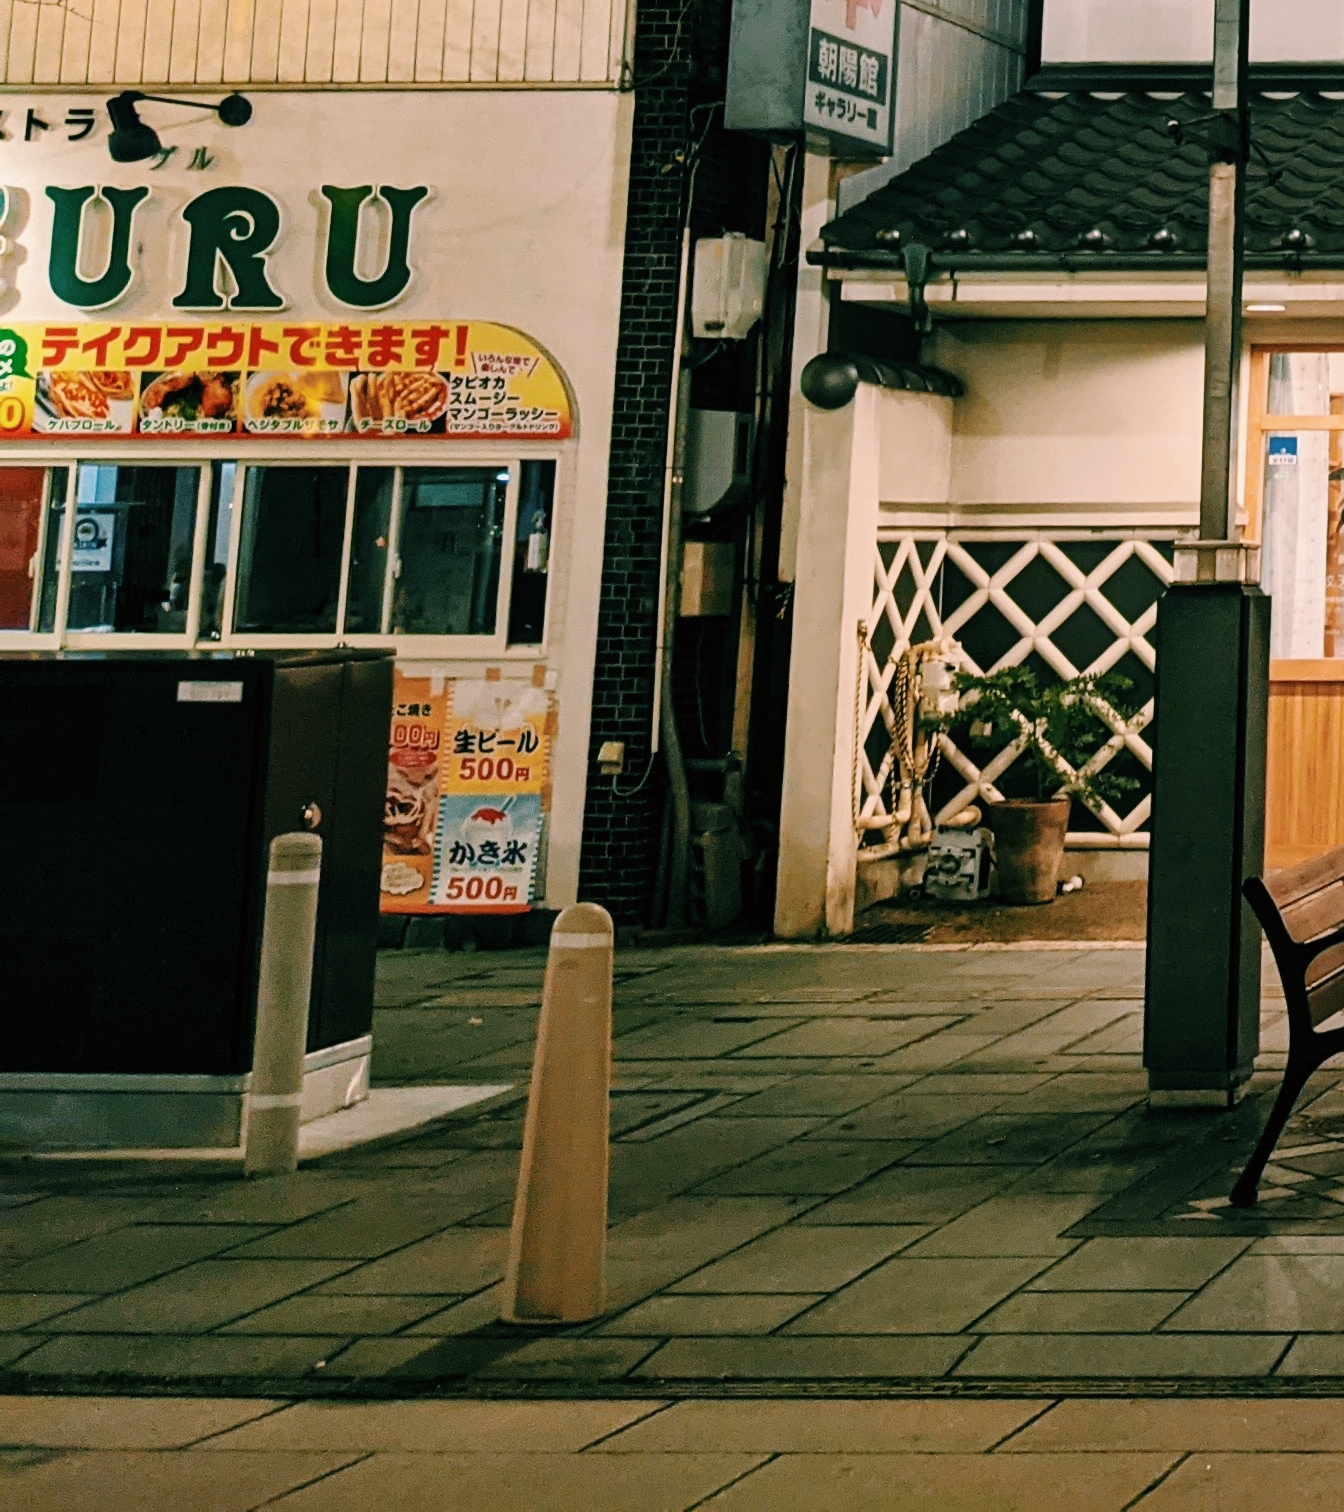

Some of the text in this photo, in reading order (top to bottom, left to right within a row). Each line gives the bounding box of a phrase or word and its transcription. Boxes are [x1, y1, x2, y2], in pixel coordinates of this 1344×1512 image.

[819, 39, 879, 96] 朝陽館
[814, 91, 878, 130] ギャラリー
[0, 108, 95, 141] トラ
[0, 185, 430, 311] URU
[41, 325, 469, 367] テイクアウトできます!
[451, 376, 505, 390] タピオカ
[450, 392, 520, 405] スムージー
[450, 408, 558, 420] マンゴーラッシー
[453, 729, 539, 754] 生ビール
[459, 758, 530, 781] 500円
[449, 840, 528, 865] かき氷
[446, 876, 518, 901] 500円
